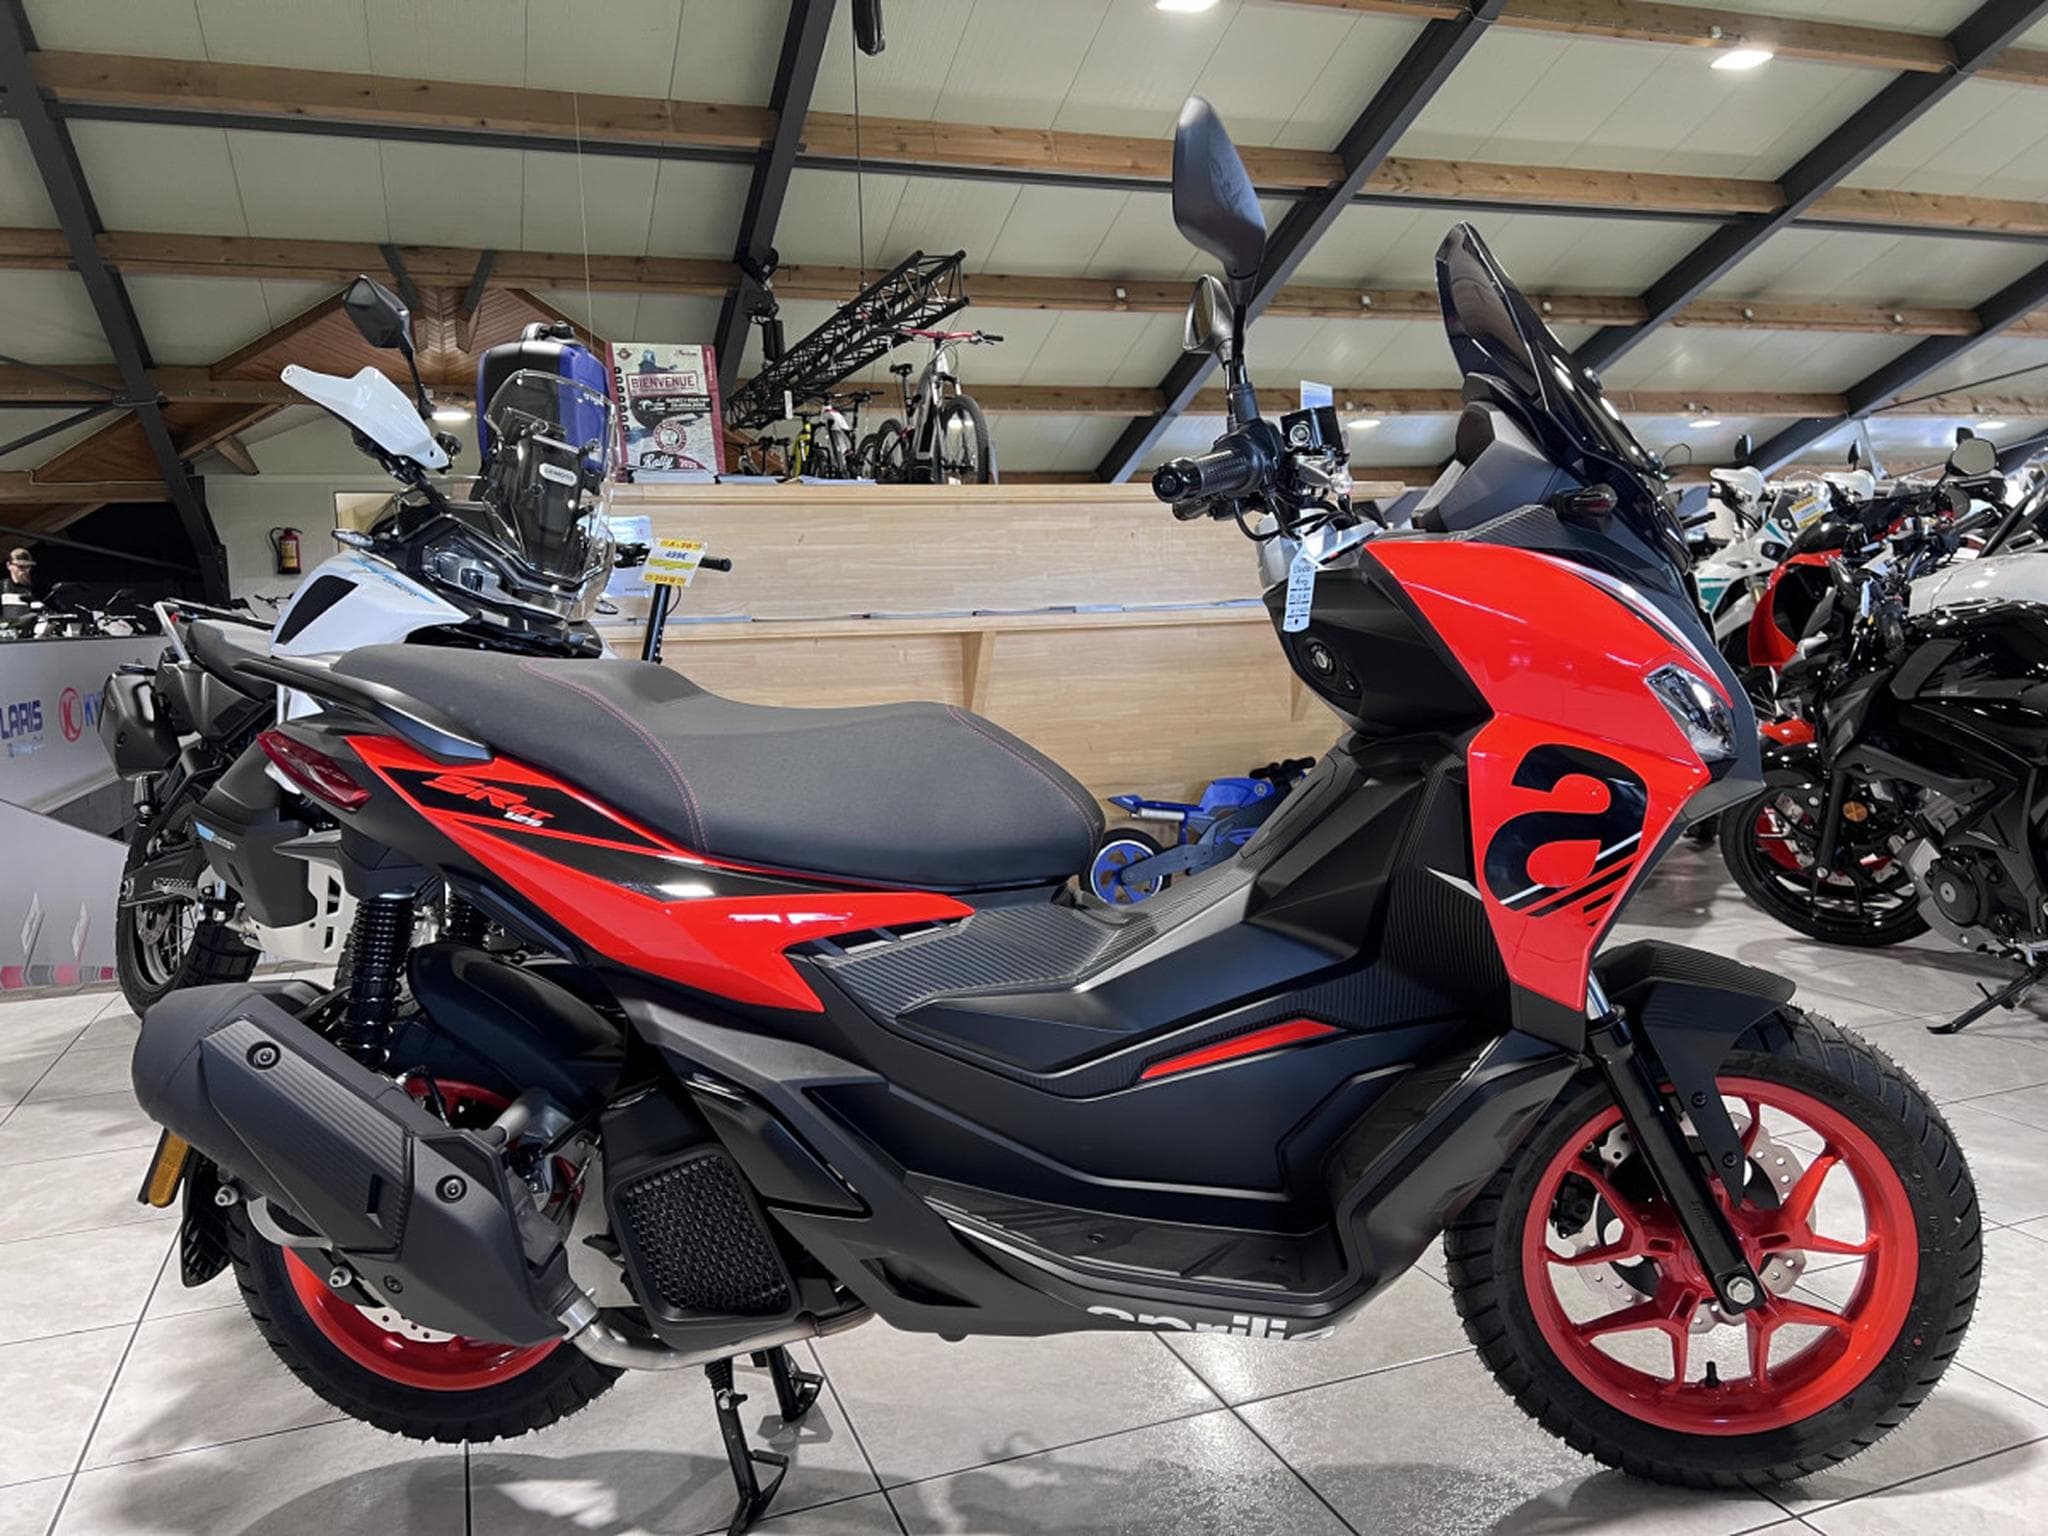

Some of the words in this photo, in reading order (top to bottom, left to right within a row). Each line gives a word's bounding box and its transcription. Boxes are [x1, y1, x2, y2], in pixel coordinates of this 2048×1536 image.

[631, 375, 695, 389] BIENVENUE
[642, 453, 674, 470] Rally
[421, 774, 528, 810] SR
[1483, 743, 1648, 917] a
